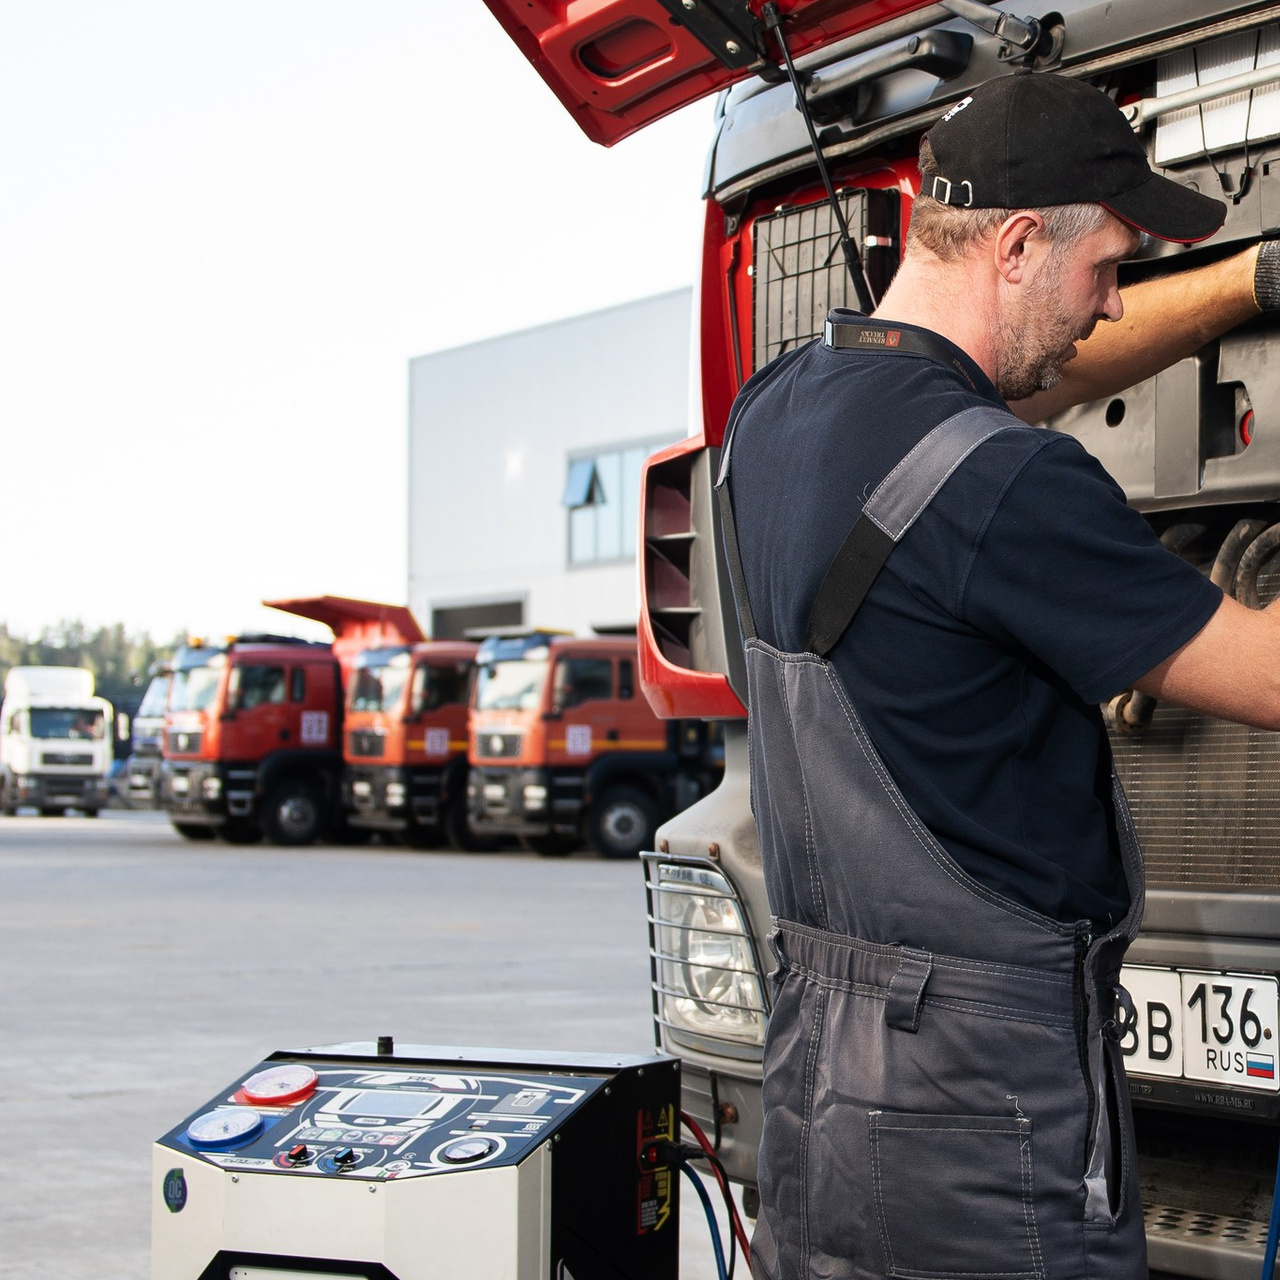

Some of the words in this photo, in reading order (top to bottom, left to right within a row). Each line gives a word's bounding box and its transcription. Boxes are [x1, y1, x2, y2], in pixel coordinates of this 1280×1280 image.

[859, 336, 886, 345] RENAULT
[860, 330, 885, 338] TRUCKS
[1187, 982, 1262, 1048] 136
[1206, 1048, 1244, 1073] RUS
[168, 1179, 182, 1199] QC
